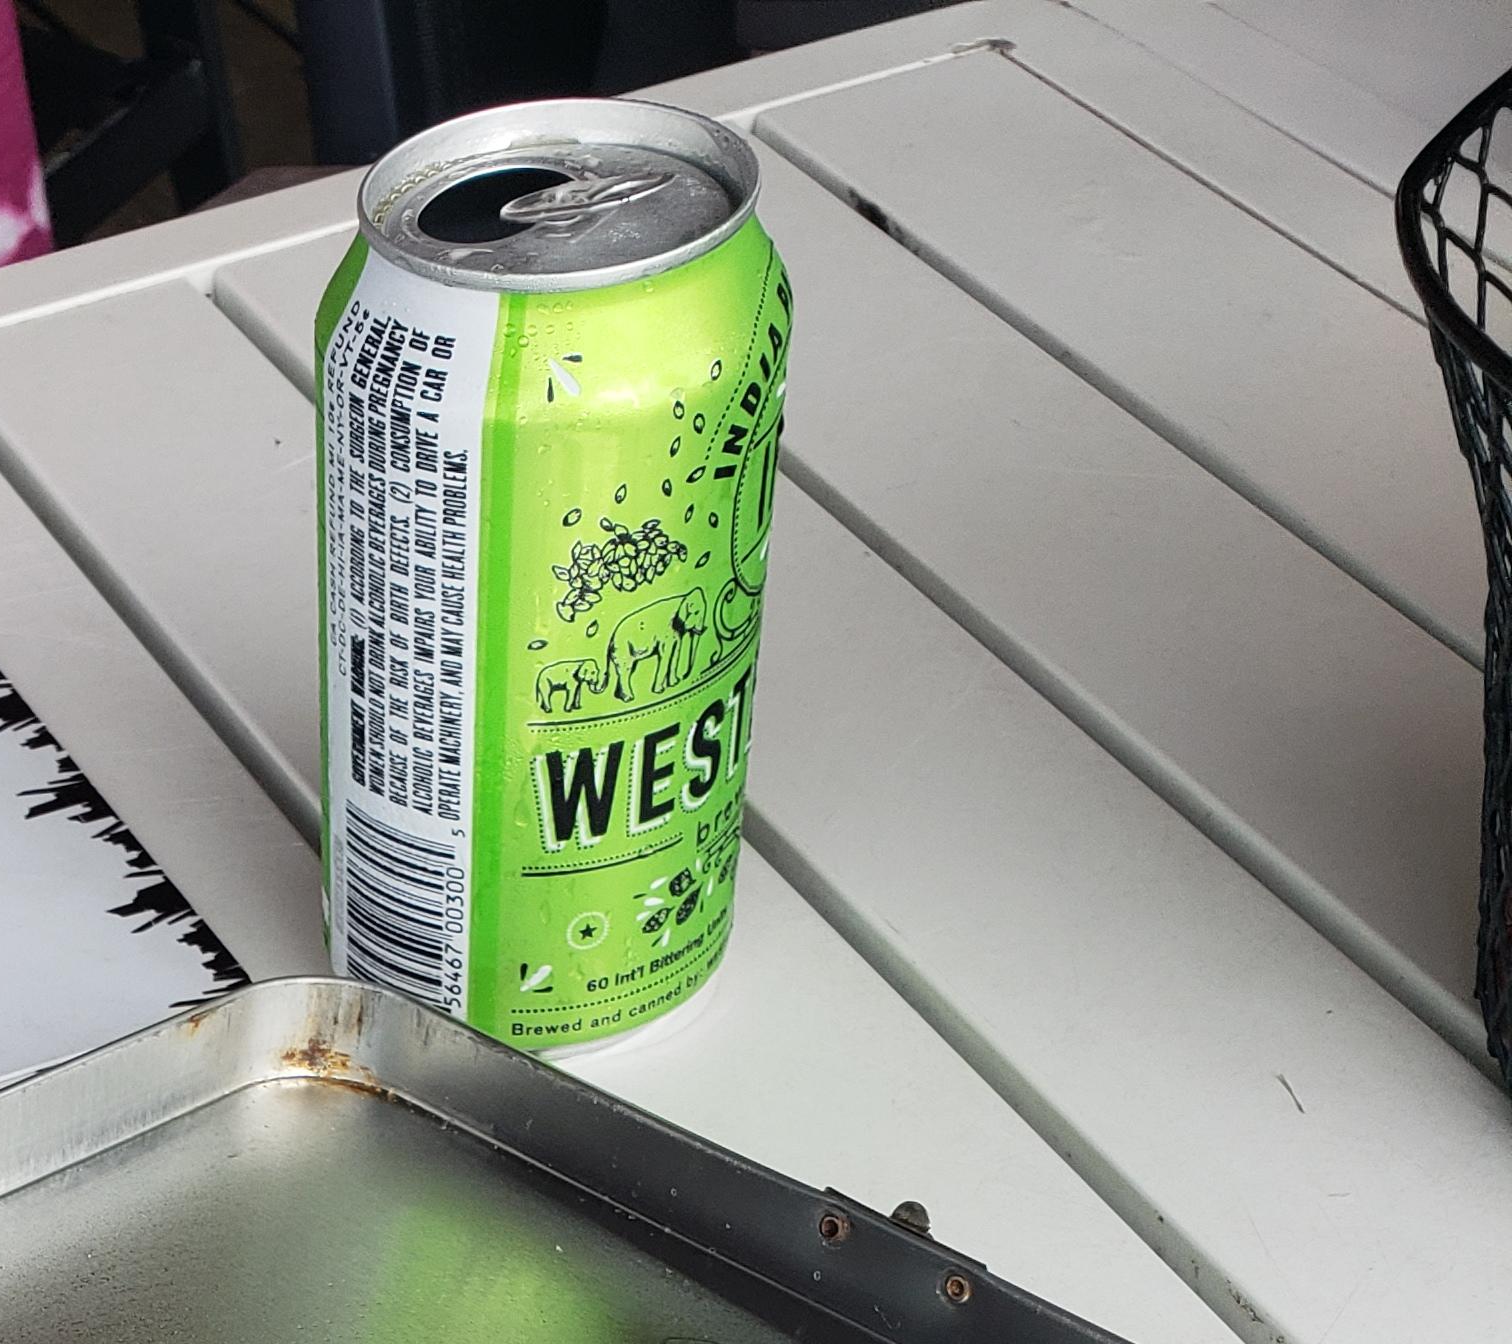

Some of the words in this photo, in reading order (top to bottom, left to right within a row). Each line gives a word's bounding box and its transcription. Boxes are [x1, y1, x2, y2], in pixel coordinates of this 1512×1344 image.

[328, 300, 361, 393] REFUND
[408, 327, 431, 352] OF
[432, 334, 457, 360] OR
[368, 318, 409, 417] PREGNANCY
[420, 368, 449, 403] CAR
[349, 391, 366, 464] SURGEON
[390, 360, 423, 473] CONSUMPTION
[417, 411, 440, 423] A
[714, 323, 783, 480] INDIA
[368, 417, 387, 474] DURING
[416, 428, 439, 473] DRIVE
[350, 464, 366, 496] THE
[388, 480, 413, 504] (2)
[415, 479, 438, 498] TO
[443, 449, 469, 528] PROBLEMS.
[350, 499, 366, 521] TO
[368, 472, 387, 554] BEVERAGES
[415, 504, 437, 560] ABILITY
[350, 524, 366, 606] ACCORDING
[390, 515, 410, 577] DEFECTS.
[442, 530, 467, 581] HEALTH
[368, 553, 386, 629] ALCOHOLIC
[390, 582, 410, 625] BIRTH
[414, 564, 437, 601] YOUR
[441, 582, 465, 626] CAUSE
[368, 627, 386, 670] DRINK
[390, 630, 409, 650] OF
[414, 608, 436, 664] IMPAIRS
[441, 627, 465, 657] MAY
[369, 669, 386, 698] NOT
[389, 656, 409, 689] RISK
[440, 660, 463, 688] AND
[369, 697, 386, 750] SHOULD
[389, 694, 409, 720] THE
[413, 669, 435, 743] BEVERAGES
[438, 691, 465, 766] MACHINERY,
[389, 725, 409, 746] OF
[369, 747, 386, 797] WOMEN
[389, 750, 409, 809] BECAUSE
[412, 746, 434, 816] ALCOHOLIC
[438, 767, 462, 821] OPERATE
[451, 828, 466, 840] 5
[444, 866, 466, 935] 00300
[443, 943, 464, 1009] 56467
[586, 976, 609, 993] 60
[649, 932, 706, 974] Bittering
[511, 1017, 583, 1037] Brewed
[590, 1009, 622, 1030] and
[628, 983, 682, 1018] canned
